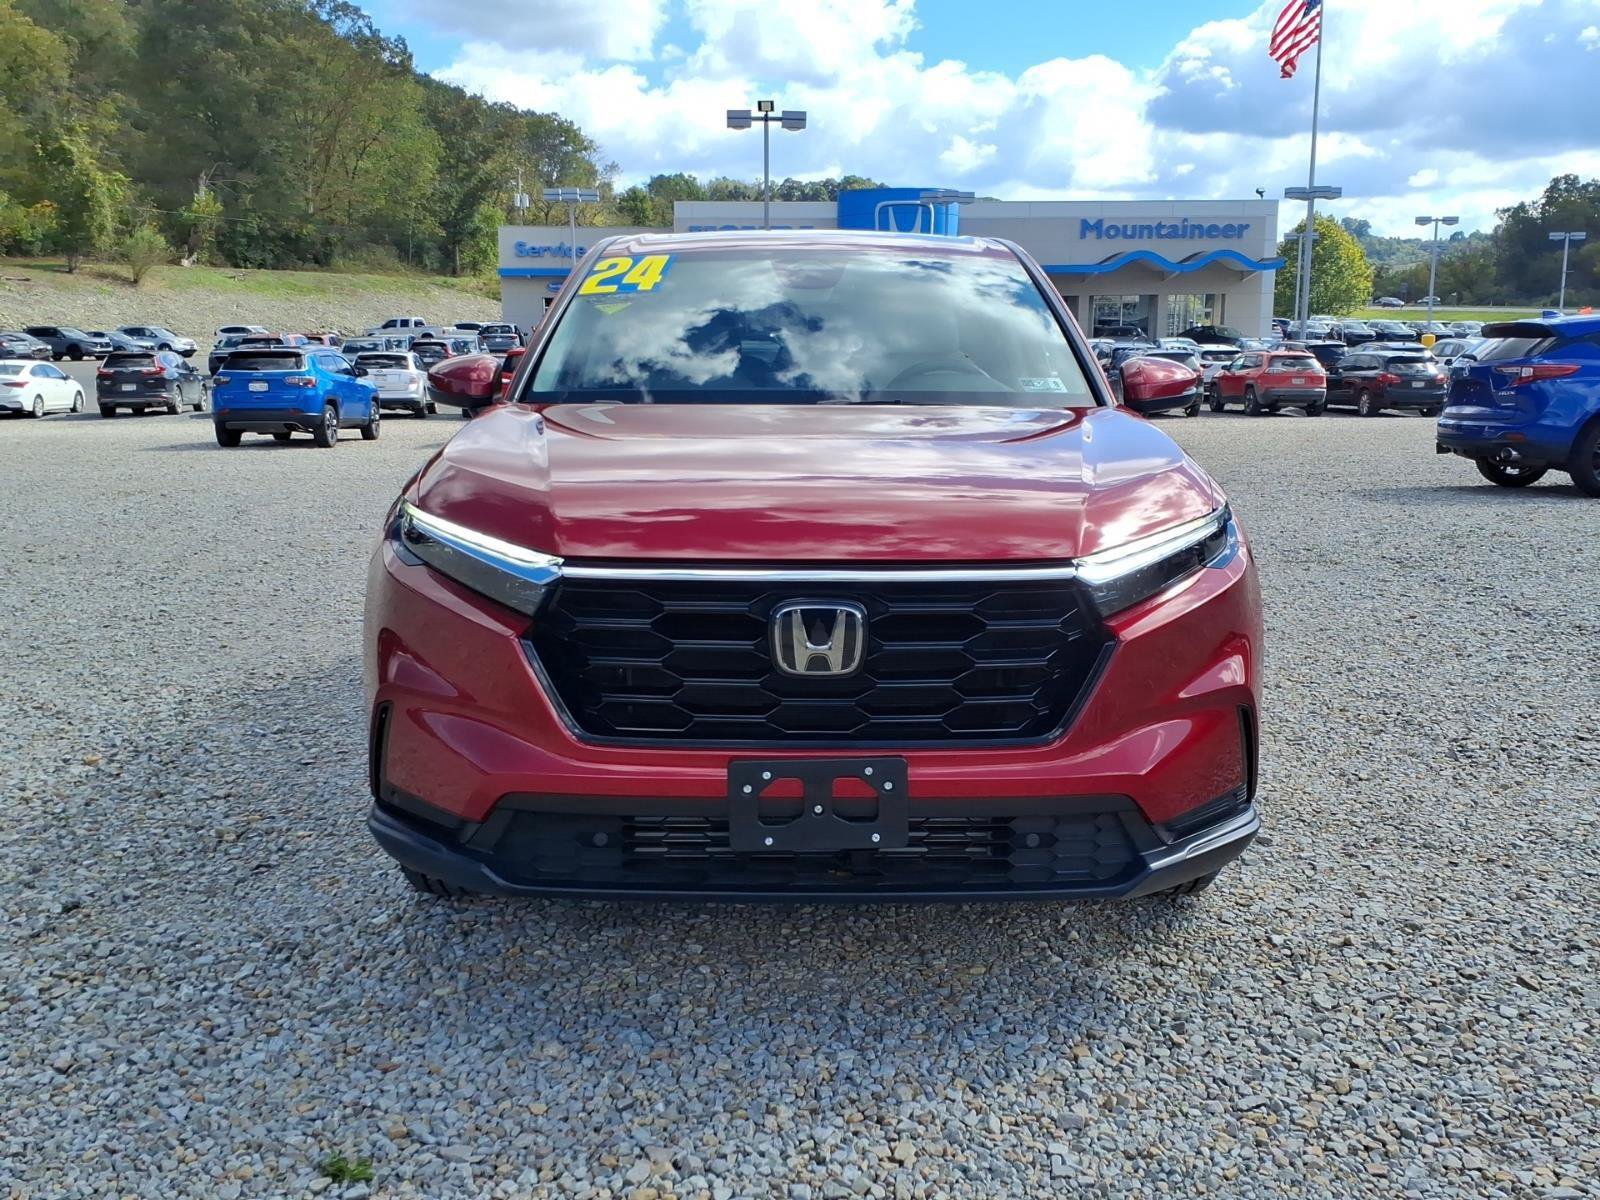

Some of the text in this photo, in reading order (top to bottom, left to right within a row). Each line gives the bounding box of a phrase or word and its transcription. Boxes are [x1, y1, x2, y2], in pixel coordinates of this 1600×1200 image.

[1080, 218, 1250, 240] Mountaineer
[514, 240, 587, 257] Service
[579, 255, 670, 295] 24
